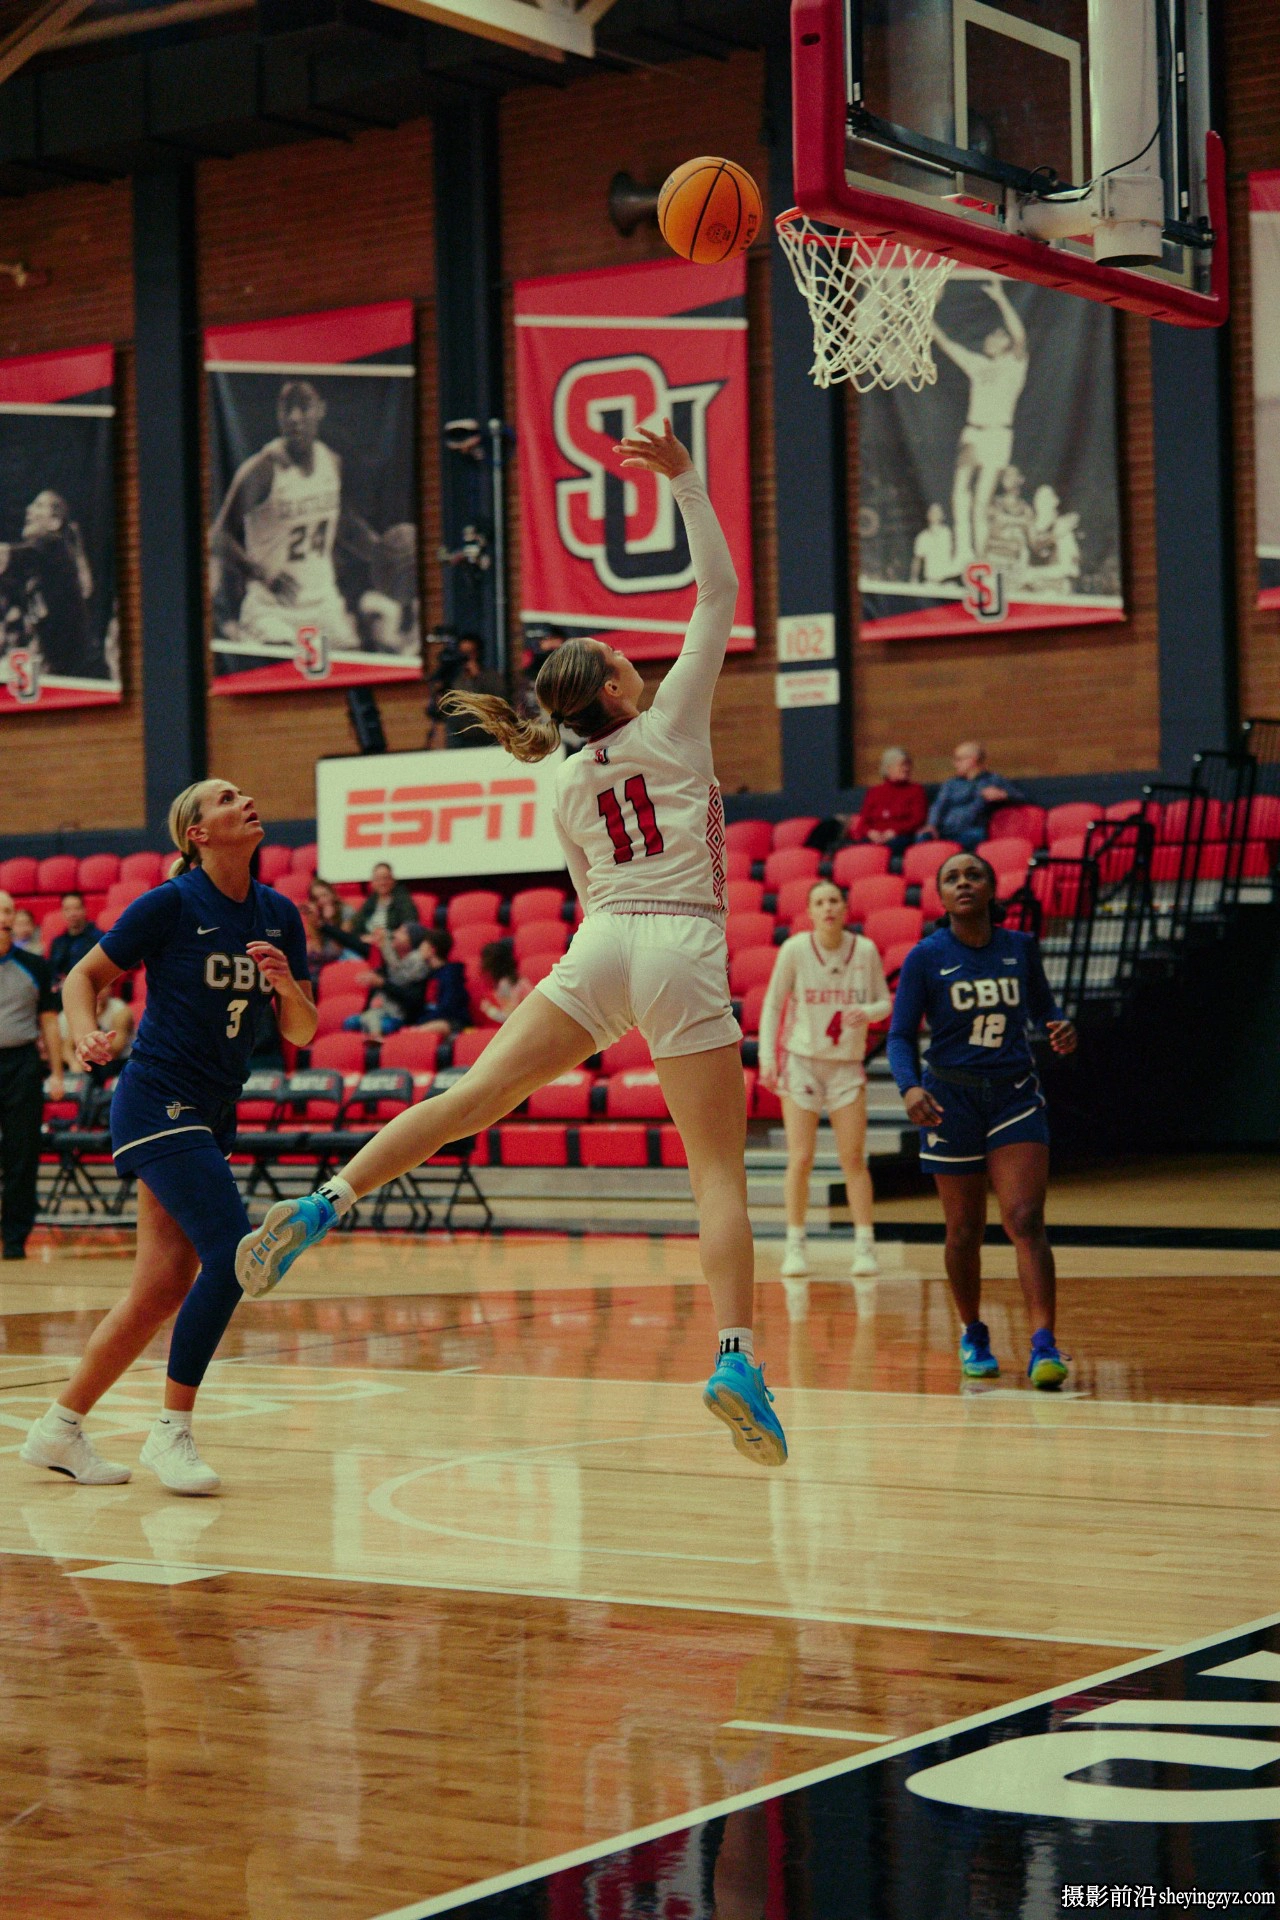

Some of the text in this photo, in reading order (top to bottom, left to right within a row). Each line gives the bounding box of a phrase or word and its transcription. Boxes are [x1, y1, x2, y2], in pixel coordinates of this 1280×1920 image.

[287, 518, 330, 562] 24
[785, 626, 826, 657] 102
[343, 777, 537, 850] ESPN
[597, 773, 664, 865] 11
[949, 976, 1021, 1011] CBU
[226, 999, 249, 1039] 3
[825, 1010, 843, 1047] 4
[968, 1013, 1007, 1048] 12
